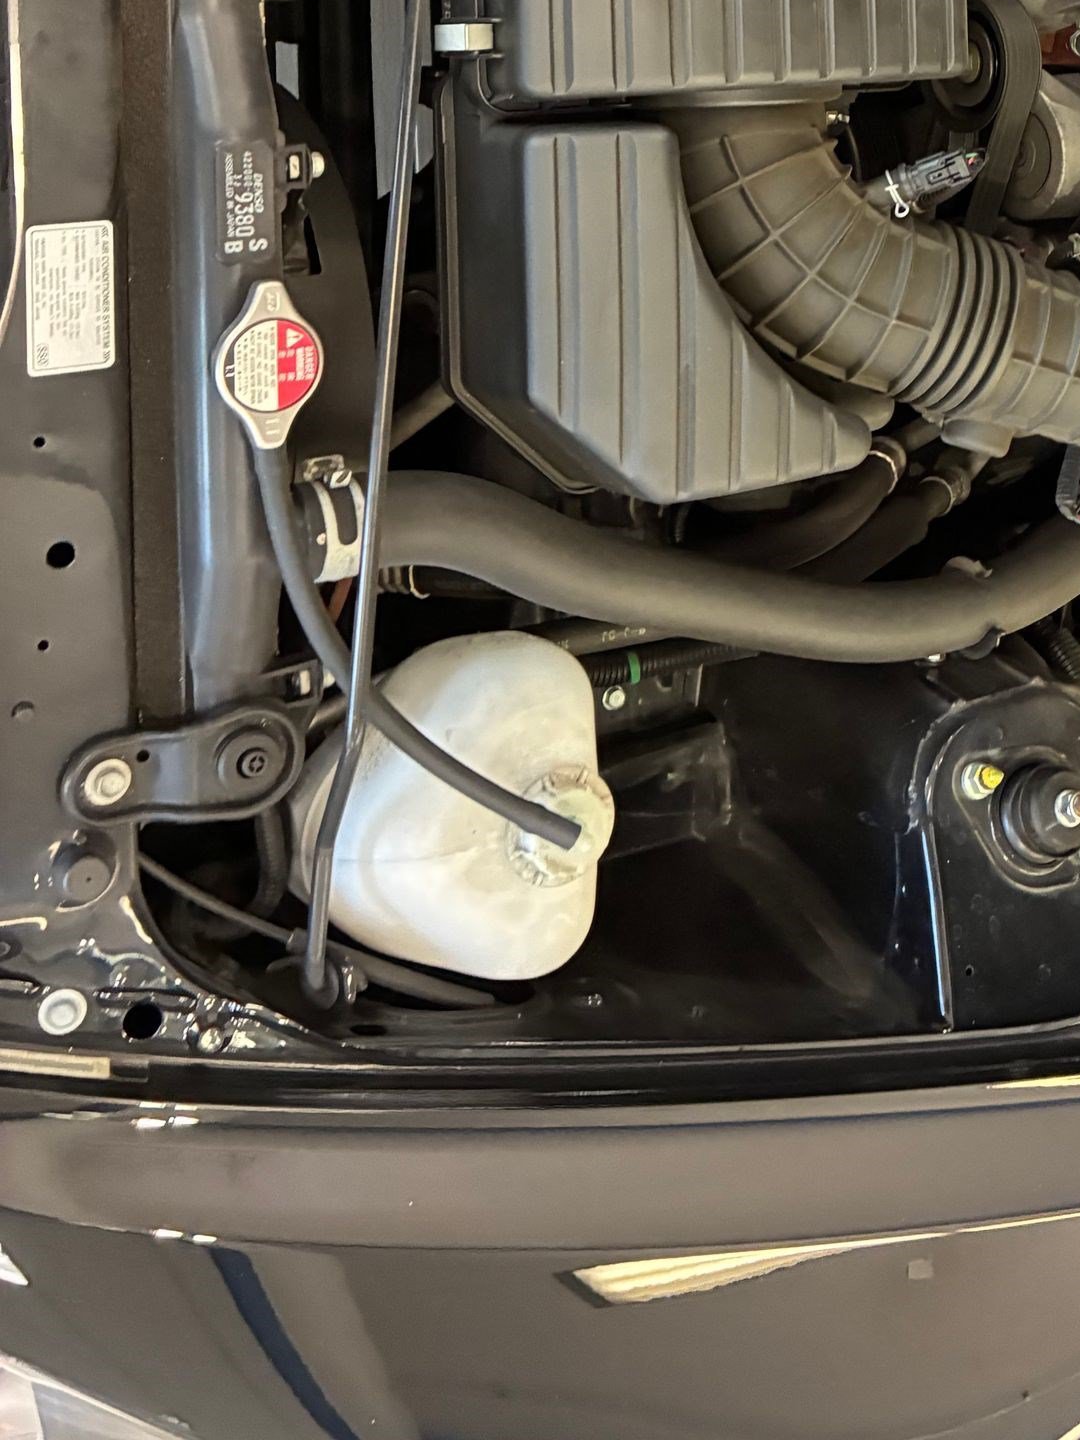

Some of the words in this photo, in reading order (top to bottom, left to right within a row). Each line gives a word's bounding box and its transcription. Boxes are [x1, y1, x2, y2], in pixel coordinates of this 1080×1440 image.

[253, 173, 265, 213] DENSO
[226, 212, 234, 238] JAPAN
[102, 240, 110, 254] AIR
[224, 240, 244, 254] B
[248, 238, 269, 252] S
[102, 255, 110, 313] CONDITIONER
[102, 314, 111, 349] SYSTEM
[304, 345, 314, 380] DANGER
